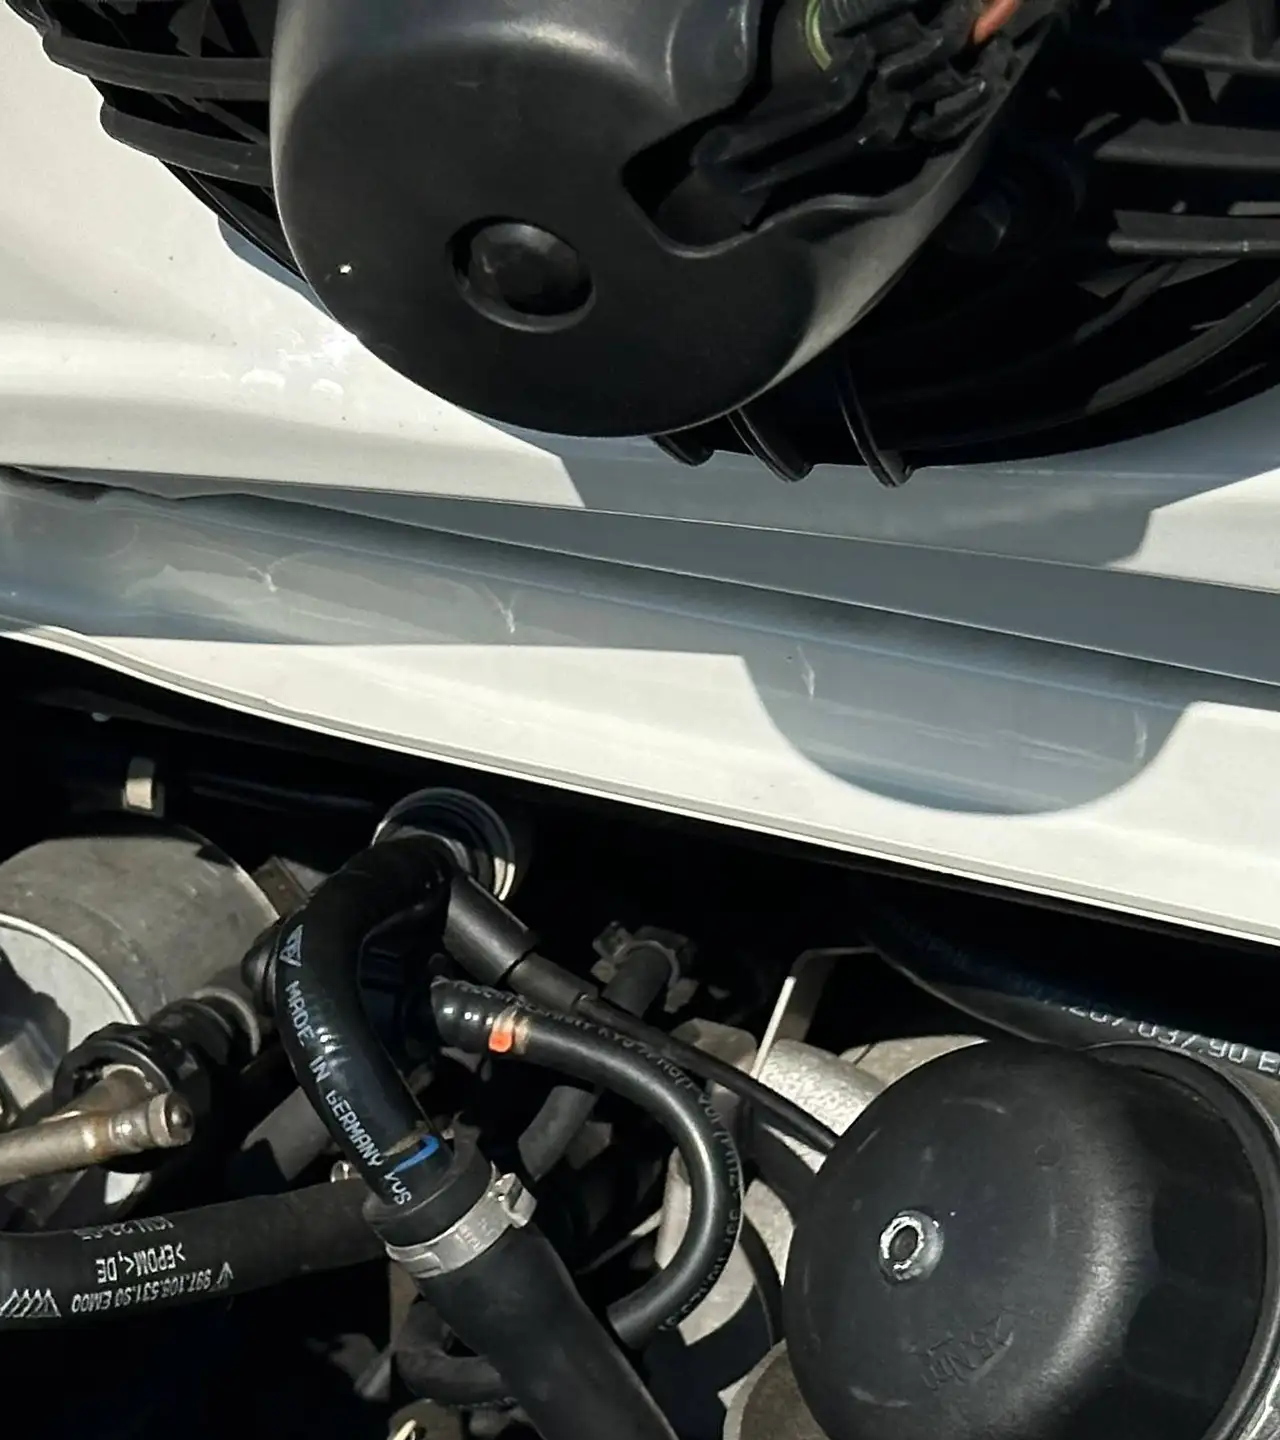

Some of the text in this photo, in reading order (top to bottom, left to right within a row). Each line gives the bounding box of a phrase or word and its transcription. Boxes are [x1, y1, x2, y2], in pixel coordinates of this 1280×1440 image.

[285, 979, 316, 1048] MADE
[308, 1055, 332, 1083] IN
[325, 1089, 385, 1167] GERMANY
[1257, 1050, 1280, 1075] E
